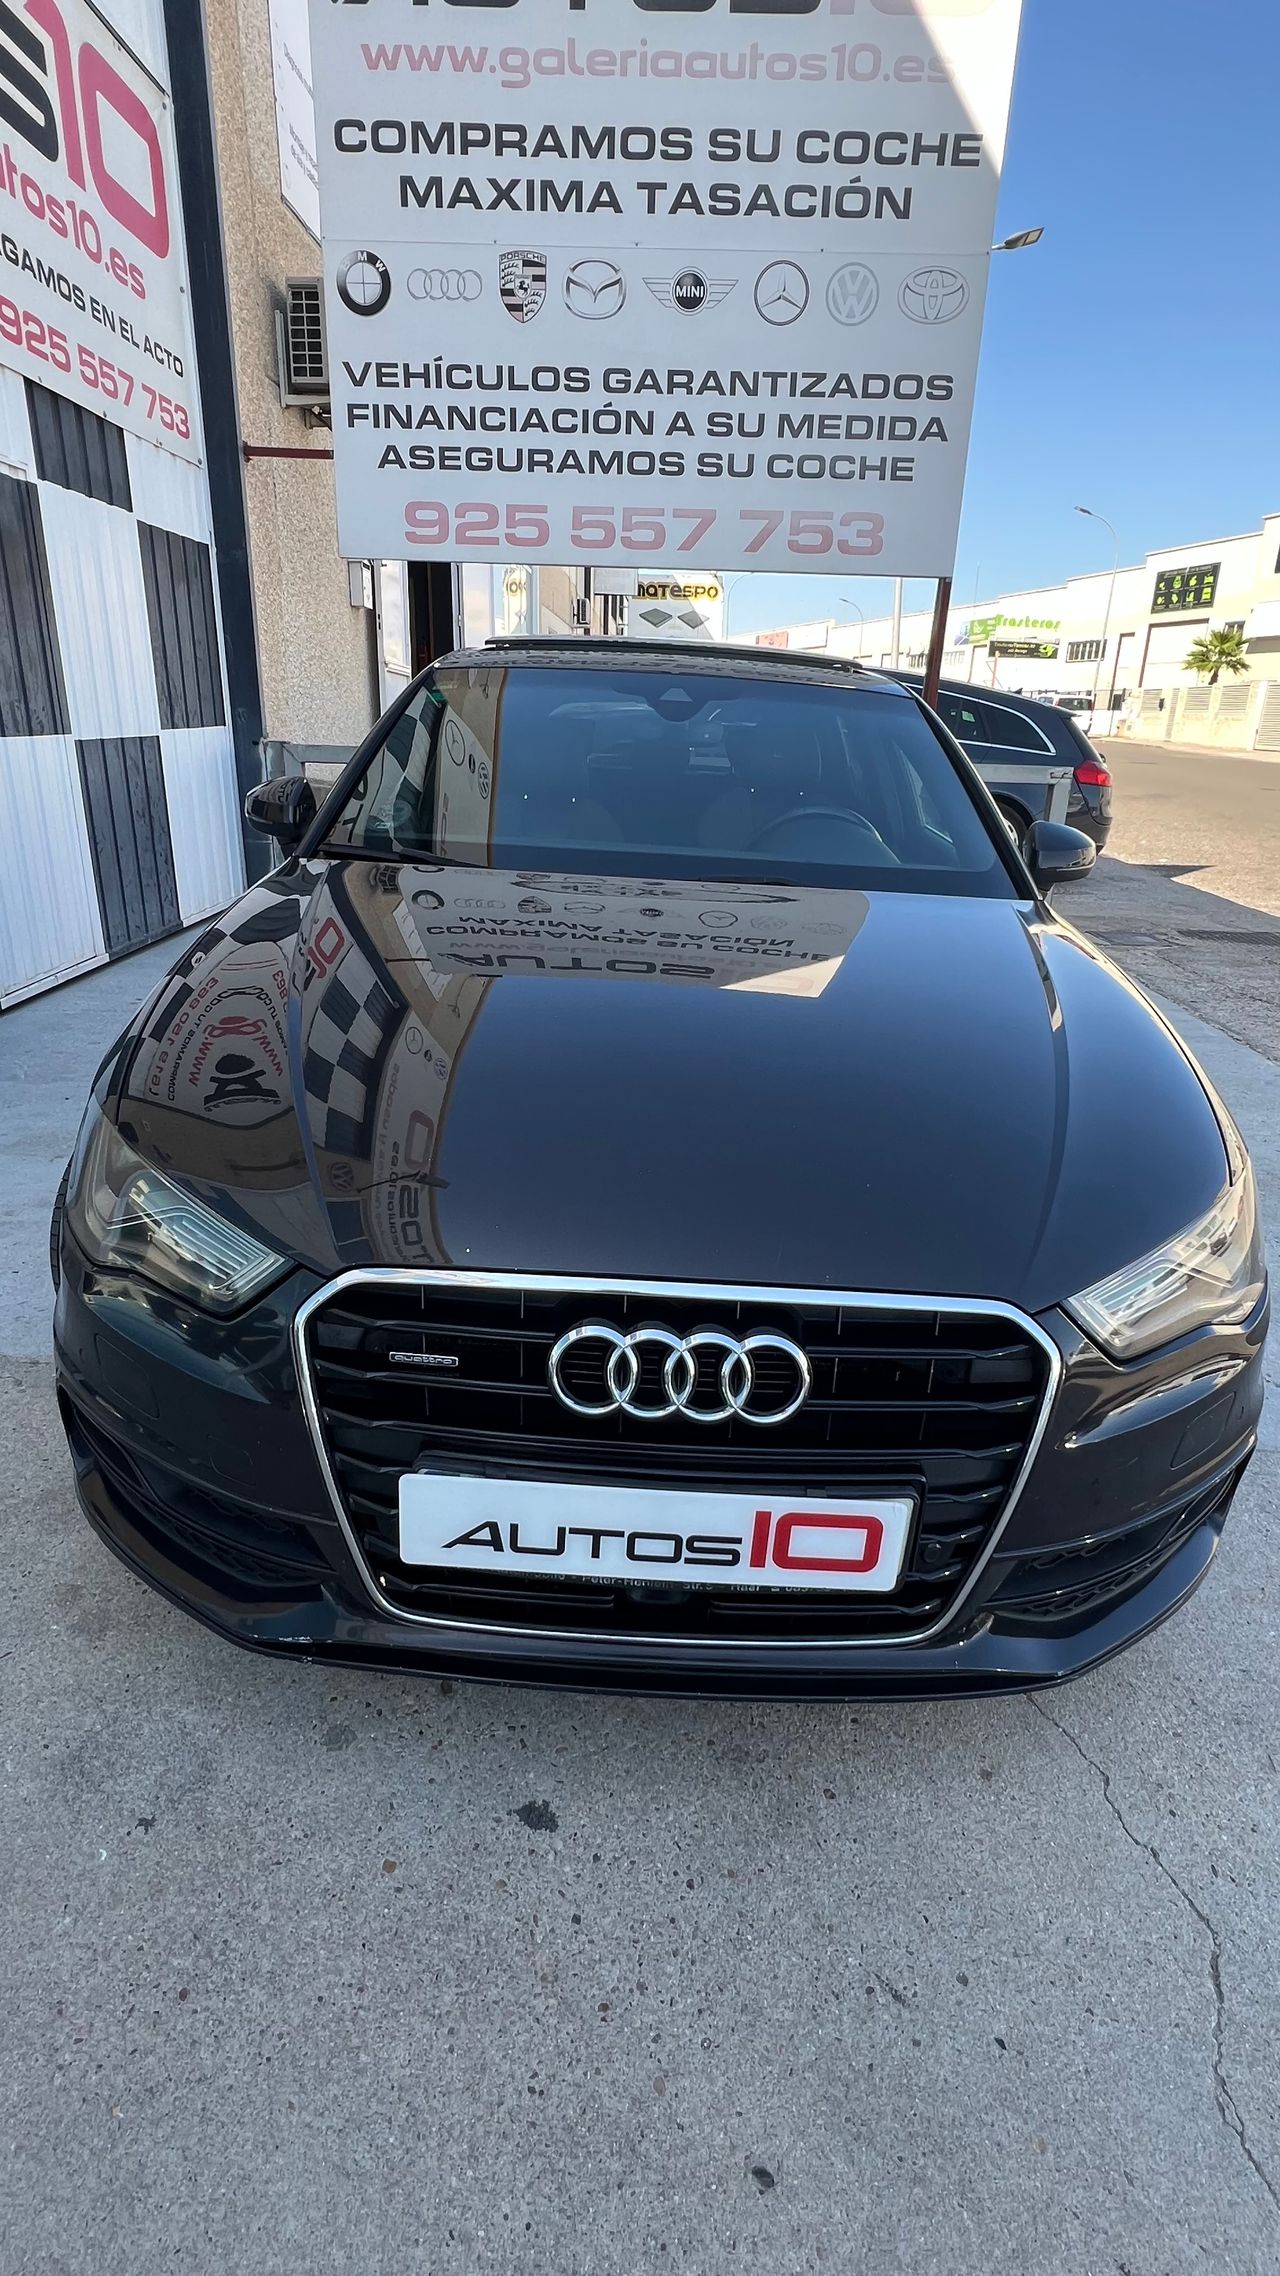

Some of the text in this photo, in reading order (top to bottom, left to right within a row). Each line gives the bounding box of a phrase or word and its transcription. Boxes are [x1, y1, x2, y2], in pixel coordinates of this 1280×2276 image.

[361, 38, 956, 89] www.galeriaautos10.es
[333, 118, 693, 162] COMPRAMOS
[707, 128, 782, 164] SU
[797, 130, 984, 168] COCHE
[399, 175, 912, 220] MAXIMA TASACIÓN
[0, 233, 184, 378] GAMOS EN EL ACTO
[675, 285, 704, 299] MINI
[0, 294, 190, 440] 925 557 753
[342, 356, 954, 400] VEHÍCULOS GARANTIZADOS
[345, 402, 949, 443] FINANCIACIÓN A SU MEDIDA
[377, 445, 914, 482] ASEGURAMOS SU COCHE
[403, 501, 885, 556] 925 557 753
[394, 1353, 453, 1365] quattro
[440, 1511, 884, 1574] AUTOS10
